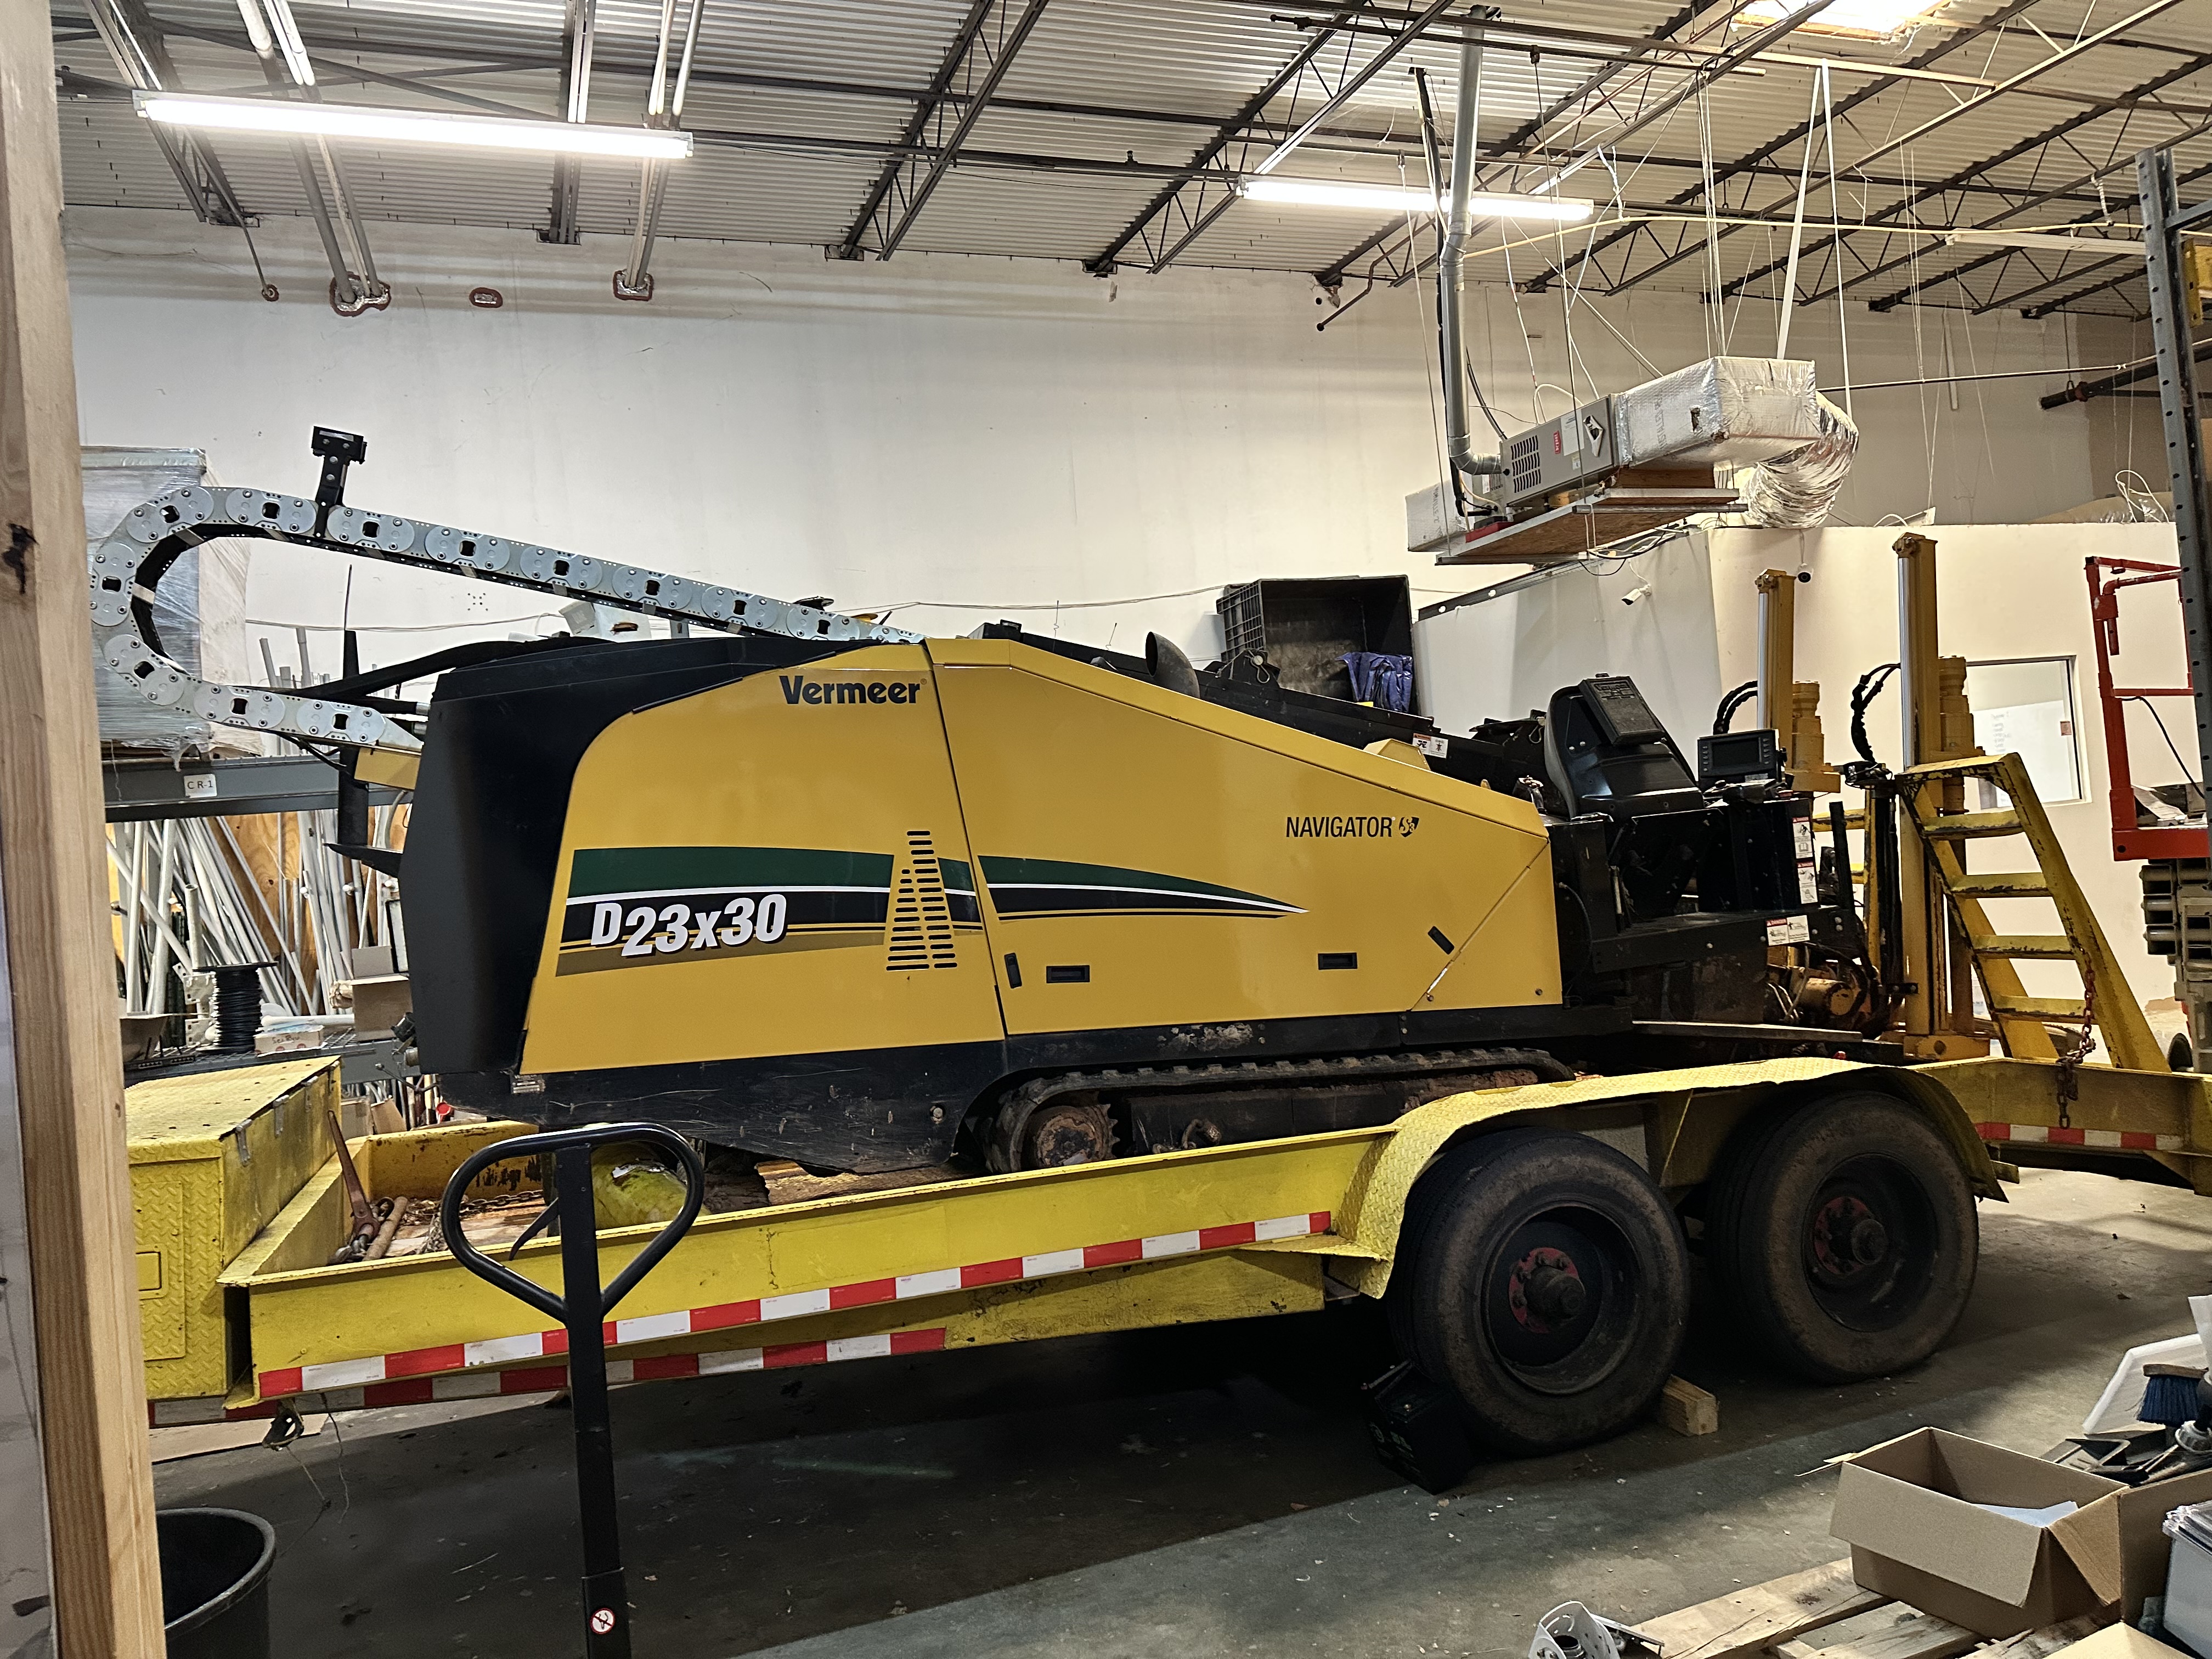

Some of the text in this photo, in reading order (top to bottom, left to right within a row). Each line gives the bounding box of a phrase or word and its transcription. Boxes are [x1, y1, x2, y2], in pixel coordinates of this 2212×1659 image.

[779, 675, 920, 704] Vermeer
[187, 780, 213, 789] C R-1
[1286, 816, 1392, 838] NAVIGATOR
[591, 894, 787, 957] D23x30
